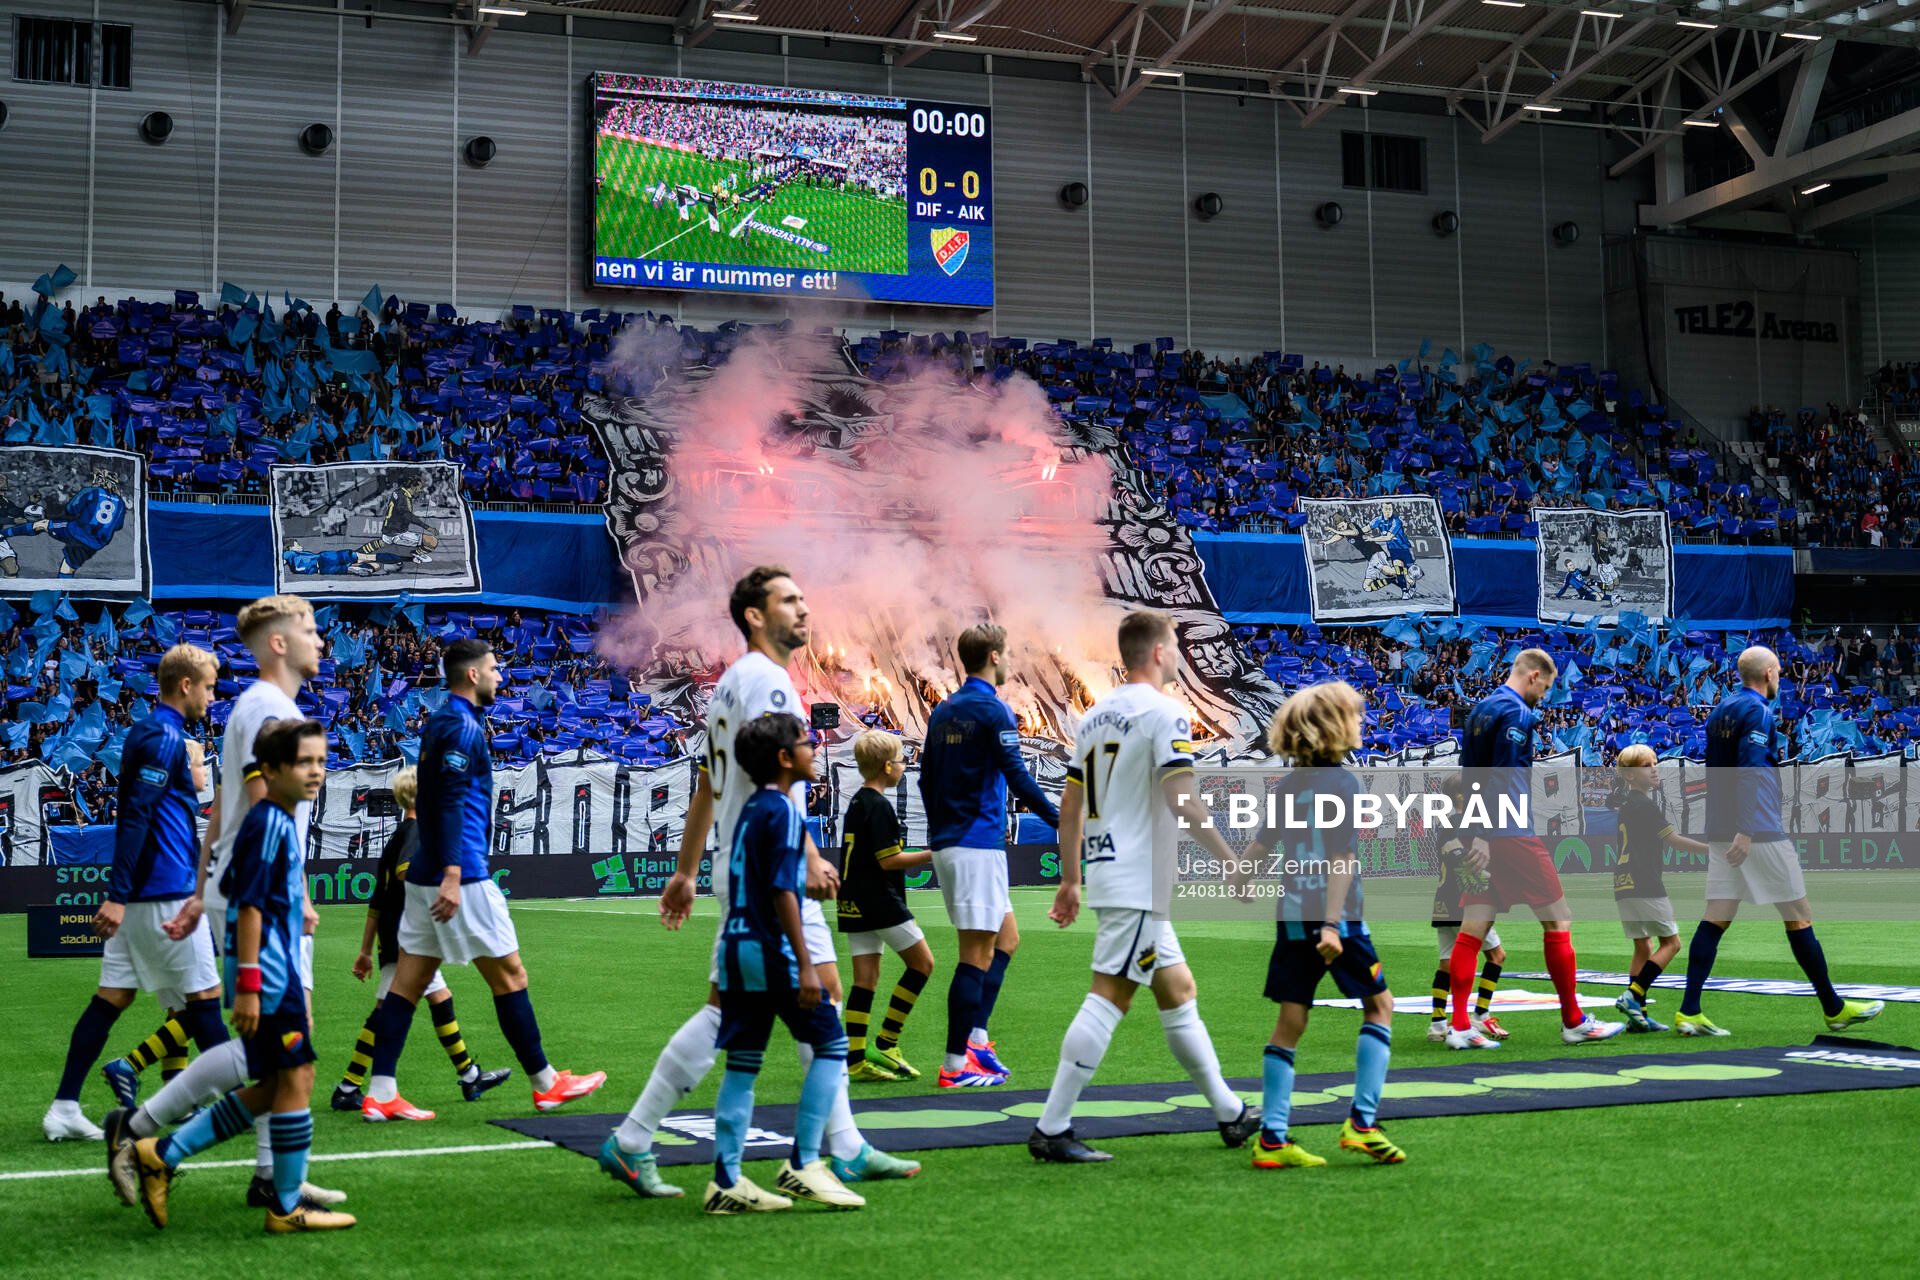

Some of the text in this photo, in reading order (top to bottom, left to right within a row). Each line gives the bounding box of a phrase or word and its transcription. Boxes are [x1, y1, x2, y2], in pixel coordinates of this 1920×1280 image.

[913, 109, 985, 137] 00:00
[919, 167, 937, 196] 0
[962, 170, 980, 199] 0
[916, 202, 942, 217] DIF
[957, 205, 985, 221] AIK
[643, 261, 663, 281] vi
[671, 262, 695, 282] är
[702, 268, 795, 288] nummer
[801, 272, 837, 290] ett!
[1674, 300, 1838, 343] TELE2 Arena
[1900, 423, 1920, 433] B31
[96, 500, 115, 524] 8
[1084, 741, 1120, 819] 17
[843, 833, 855, 880] 7
[60, 934, 102, 945] stadium
